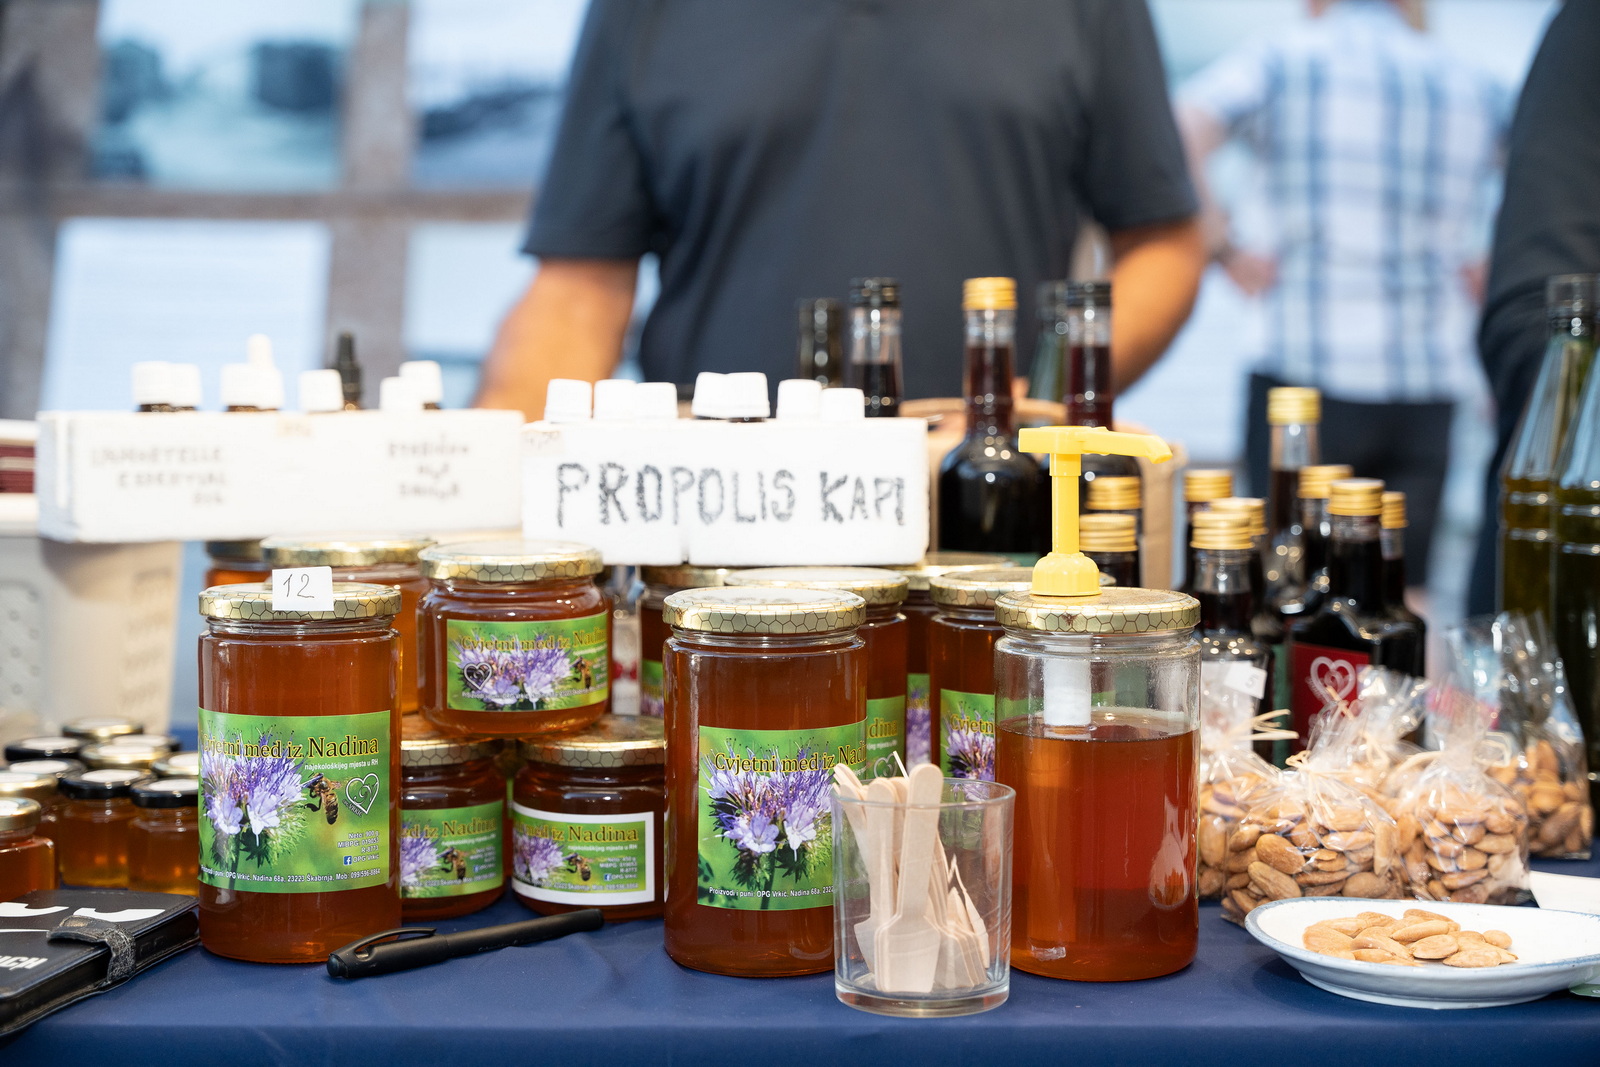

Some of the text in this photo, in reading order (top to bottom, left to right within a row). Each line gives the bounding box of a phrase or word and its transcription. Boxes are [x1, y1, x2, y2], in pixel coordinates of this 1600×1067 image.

[557, 462, 905, 527] PROPOLIS KAPI
[283, 573, 315, 599] 12
[460, 635, 519, 653] Cvjetni
[520, 635, 555, 650] med
[557, 636, 570, 649] iz
[867, 717, 898, 739] dina
[949, 713, 994, 736] Cvjetn
[244, 739, 282, 758] med
[287, 740, 303, 758] iz
[308, 734, 379, 759] Nadina
[349, 761, 366, 769] mjesta
[371, 758, 379, 766] RH
[714, 752, 776, 775] Cvjetni
[781, 752, 819, 772] med
[822, 752, 836, 770] iz
[423, 825, 438, 838] iz
[441, 817, 497, 837] Nadina
[551, 827, 565, 841] iz
[568, 825, 639, 842] Nadina
[352, 855, 366, 863] OPG
[225, 871, 236, 879] OPG
[252, 874, 272, 882] Nadina
[709, 886, 735, 896] Proizvodi
[756, 890, 771, 898] OPG
[822, 885, 834, 894] 2322
